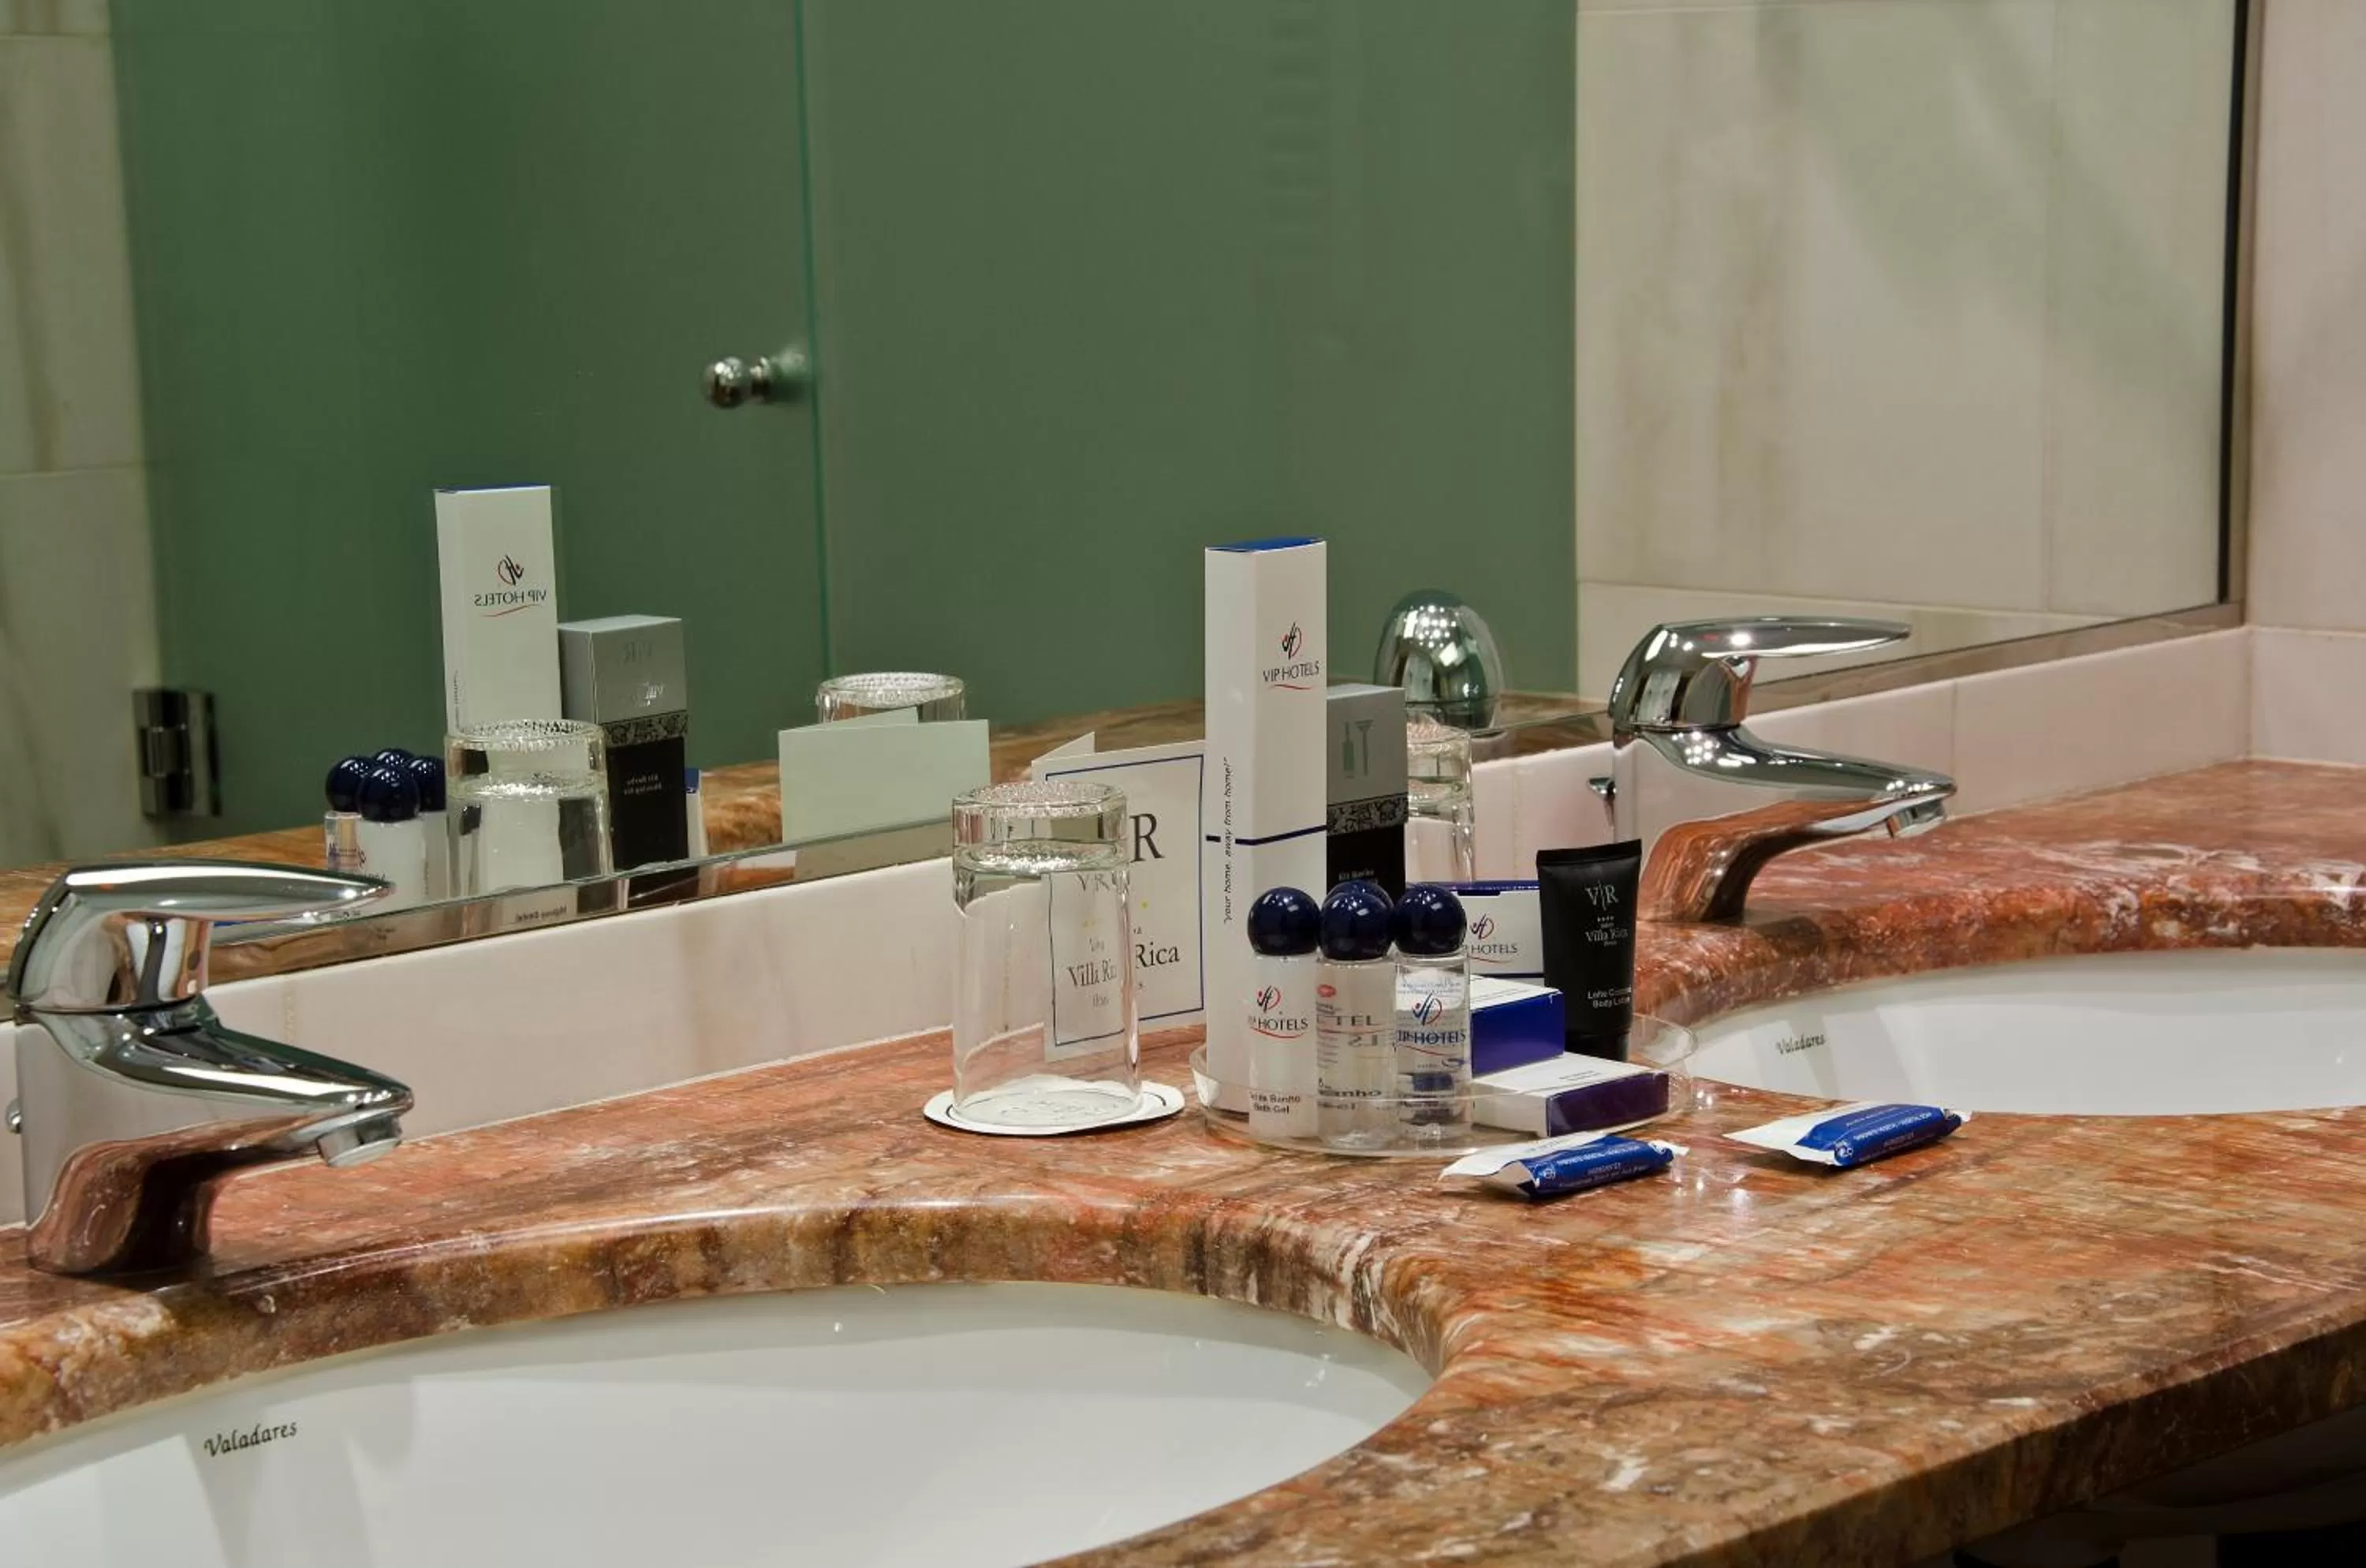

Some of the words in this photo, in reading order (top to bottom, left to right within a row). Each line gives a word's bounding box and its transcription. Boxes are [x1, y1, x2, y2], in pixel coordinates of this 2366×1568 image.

[1263, 668, 1280, 682] VIP
[1282, 661, 1319, 681] HOTELS
[1471, 943, 1518, 955] HOTELS
[1258, 1017, 1308, 1031] HOTELS
[1414, 1030, 1466, 1046] HOTELS
[203, 1421, 298, 1458] Valadares
